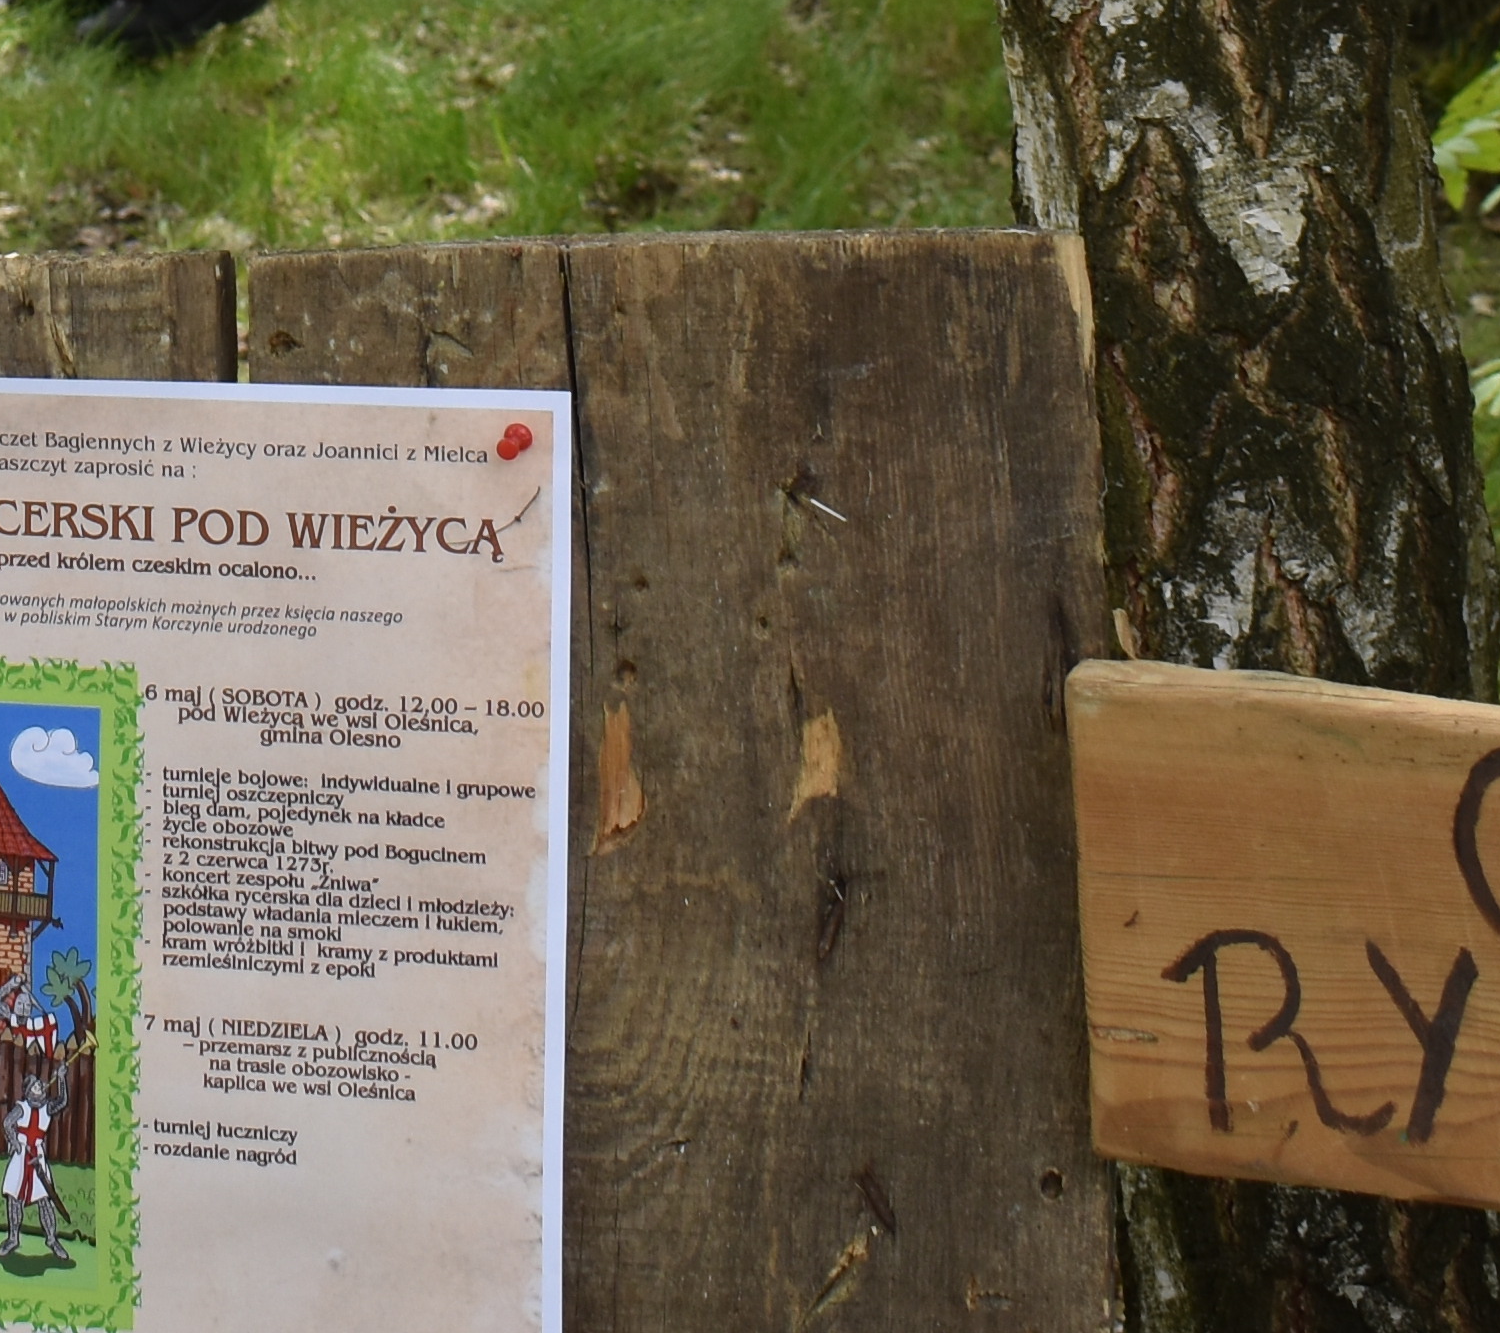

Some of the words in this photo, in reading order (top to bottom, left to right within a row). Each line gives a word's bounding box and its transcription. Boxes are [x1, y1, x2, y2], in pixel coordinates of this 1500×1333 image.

[45, 430, 156, 456] Bagiennych
[162, 438, 173, 452] z
[180, 435, 257, 460] Wieżycy
[263, 442, 307, 457] oraz
[312, 439, 399, 460] Joannici
[406, 447, 417, 461] z
[424, 444, 488, 463] Mielca
[73, 458, 155, 480] zaprosić
[161, 463, 185, 478] na
[170, 506, 270, 545] POD
[285, 506, 505, 563] WIEŻYCĄ
[56, 552, 126, 572] królem
[131, 557, 212, 576] czeskim
[4, 610, 18, 622] w
[20, 607, 91, 628] pobliskim
[94, 610, 148, 632] Starym
[151, 612, 224, 635] Korczynie
[227, 617, 317, 640] urodzonego
[69, 593, 167, 615] małopolskich
[170, 597, 237, 619] możnych
[240, 604, 281, 621] przez
[284, 601, 336, 623] księcia
[339, 608, 403, 627] naszego
[144, 683, 158, 701] 6
[164, 685, 202, 708] maj
[334, 693, 389, 715] godz.
[485, 699, 548, 719] 18.00
[178, 704, 216, 726] pod
[223, 705, 305, 731] Wieżycą
[309, 713, 339, 728] we
[344, 711, 378, 729] wsi
[384, 712, 479, 738] Oleśnica,
[259, 725, 326, 747] gmina
[328, 727, 402, 748] Olesno
[162, 766, 232, 790] turnieje
[237, 768, 309, 792] bojowe:
[320, 771, 441, 796] indywidualne
[456, 781, 537, 802] grupowe
[162, 782, 221, 806] turniej
[226, 786, 345, 810] oszczepniczy
[162, 797, 202, 822] bieg
[205, 799, 252, 823] dam,
[257, 803, 353, 827] pojedynek
[357, 811, 381, 825] na
[385, 808, 446, 828] kładce
[162, 814, 208, 837] życie
[212, 817, 294, 837] obozowe
[162, 832, 286, 858] rekonstrukcja
[291, 837, 340, 861] bitwy
[344, 840, 380, 862] pod
[384, 841, 487, 865] Bogucinem
[162, 852, 174, 866] z
[177, 848, 191, 866] 2
[196, 853, 269, 870] czerwca
[162, 864, 232, 885] koncert
[235, 870, 305, 892] zespołu
[161, 882, 231, 902] szkółka
[234, 888, 311, 909] rycerska
[315, 889, 344, 908] dla
[348, 891, 401, 911] dzieci
[417, 895, 515, 922] młodzieży:
[162, 899, 248, 925] podstawy
[252, 903, 333, 924] władania
[337, 908, 420, 929] mieczem
[435, 913, 504, 938] łukiem,
[162, 916, 255, 938] polowanie
[259, 924, 283, 939] na
[286, 923, 342, 942] smoki
[161, 931, 207, 951] kram
[212, 935, 295, 956] wróżbitki
[316, 940, 374, 966] kramy
[378, 948, 389, 962] z
[393, 946, 499, 968] produktami
[162, 951, 305, 978] rzemieślniczymi
[310, 961, 321, 975] z
[325, 959, 376, 981] epoki
[144, 1014, 156, 1032] 7
[163, 1016, 201, 1039] maj
[354, 1027, 409, 1049] godz.
[419, 1029, 479, 1050] 11.00
[198, 1042, 293, 1061] przemarsz
[296, 1046, 308, 1060] z
[312, 1044, 437, 1071] publicznością
[208, 1058, 232, 1073] na
[236, 1056, 287, 1076] trasie
[291, 1059, 400, 1082] obozowisko
[203, 1071, 267, 1095] kaplica
[271, 1079, 298, 1094] we
[302, 1078, 332, 1096] wsi
[337, 1079, 417, 1101] Oleśnica
[153, 1117, 211, 1141] turniej
[216, 1119, 299, 1146] łuczniczy
[153, 1140, 231, 1161] rozdanie
[235, 1147, 298, 1168] nagród
